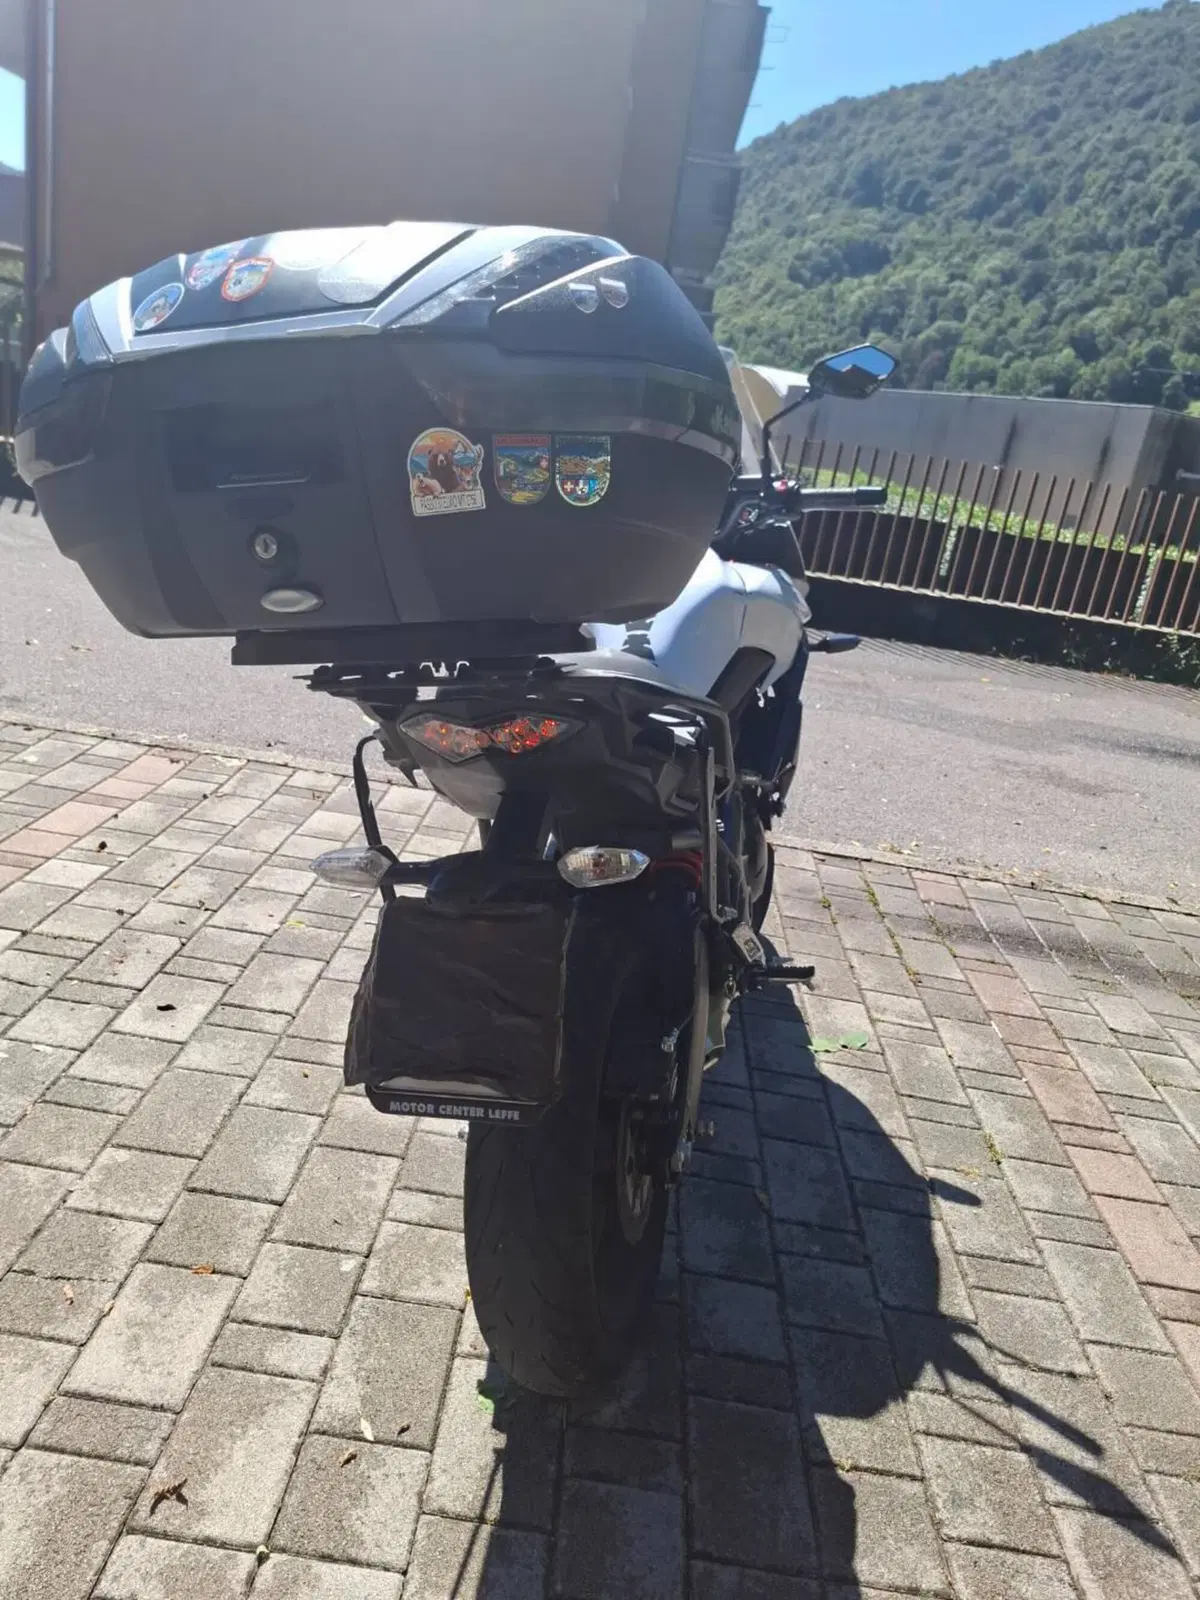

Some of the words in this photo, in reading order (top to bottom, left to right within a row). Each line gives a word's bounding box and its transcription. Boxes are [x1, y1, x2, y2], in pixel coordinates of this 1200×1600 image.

[389, 1101, 435, 1114] MOTOR
[438, 1104, 485, 1118] CENTER
[488, 1108, 520, 1121] LEFFE
